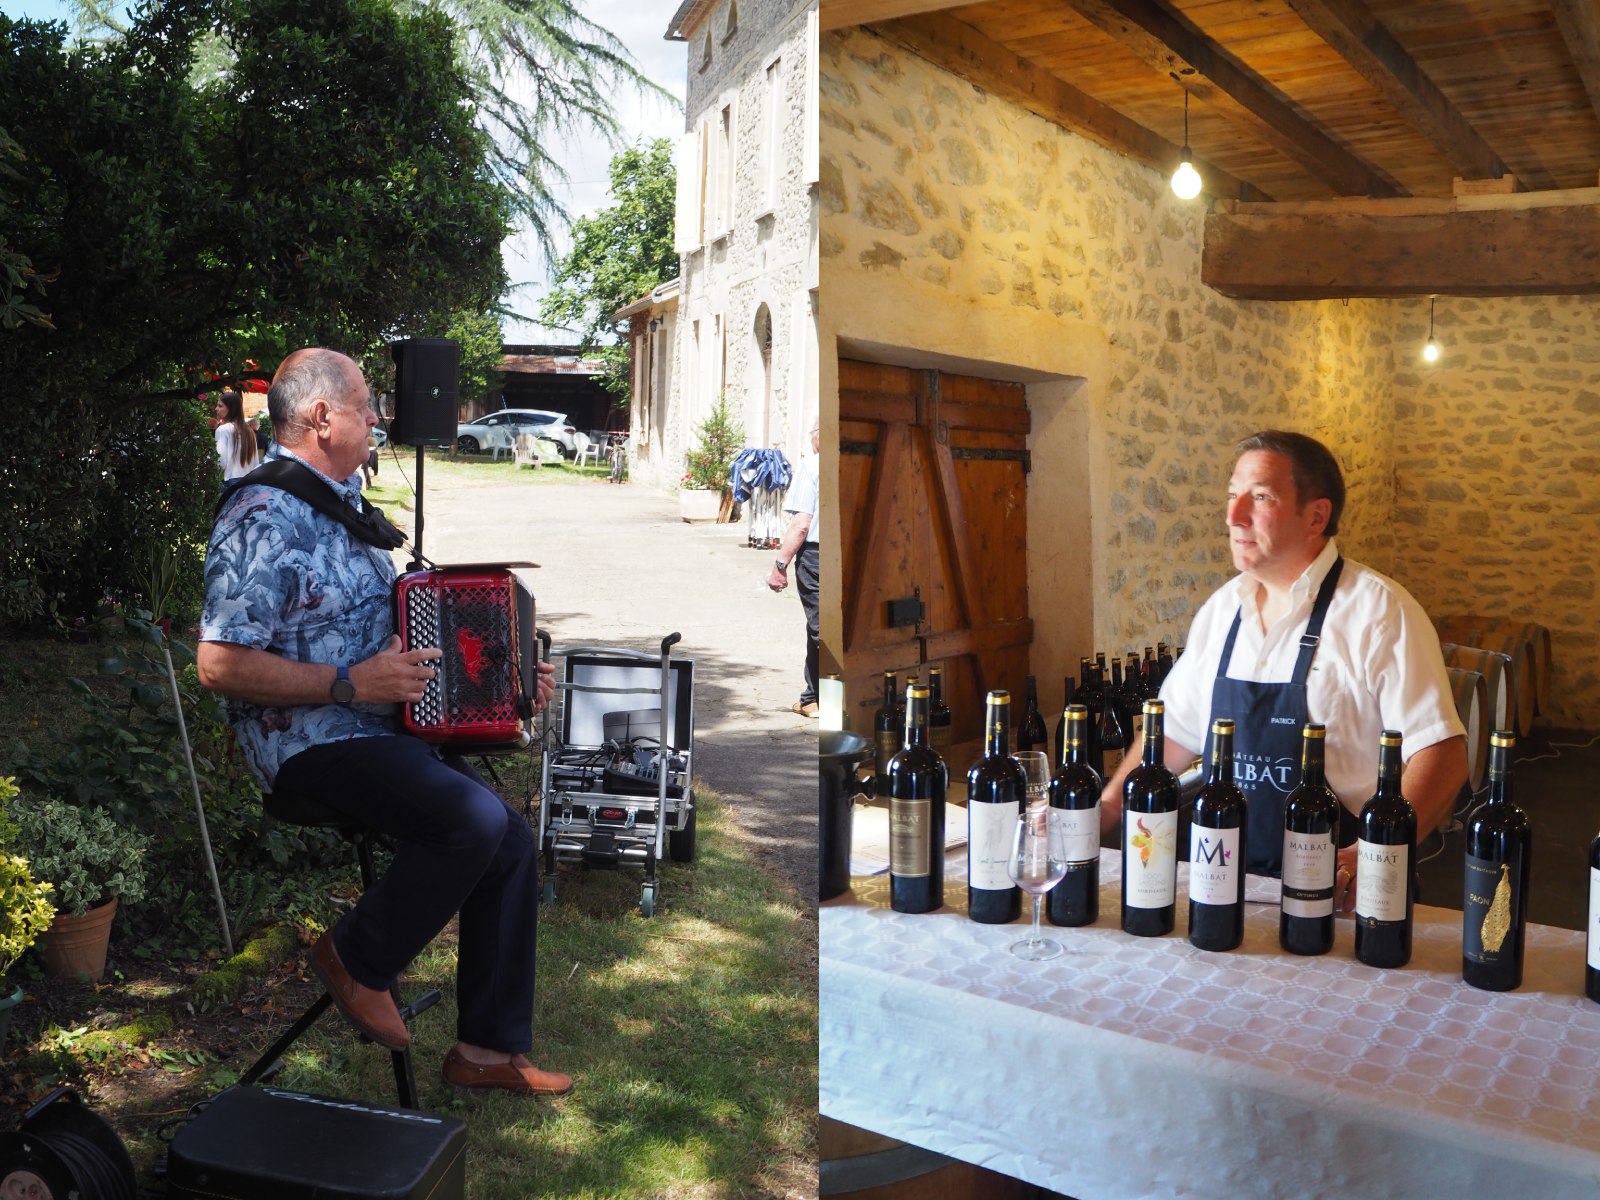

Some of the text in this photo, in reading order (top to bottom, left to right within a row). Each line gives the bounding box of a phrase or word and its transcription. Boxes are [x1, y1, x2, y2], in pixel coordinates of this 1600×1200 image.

[1270, 717, 1296, 725] PATRICK
[1233, 751, 1271, 763] ÂTEAU
[1233, 761, 1293, 793] LBAT
[1195, 836, 1230, 867] M
[1289, 841, 1328, 852] MALBAT
[1358, 849, 1400, 867] MALBAT
[1469, 893, 1490, 906] PAON
